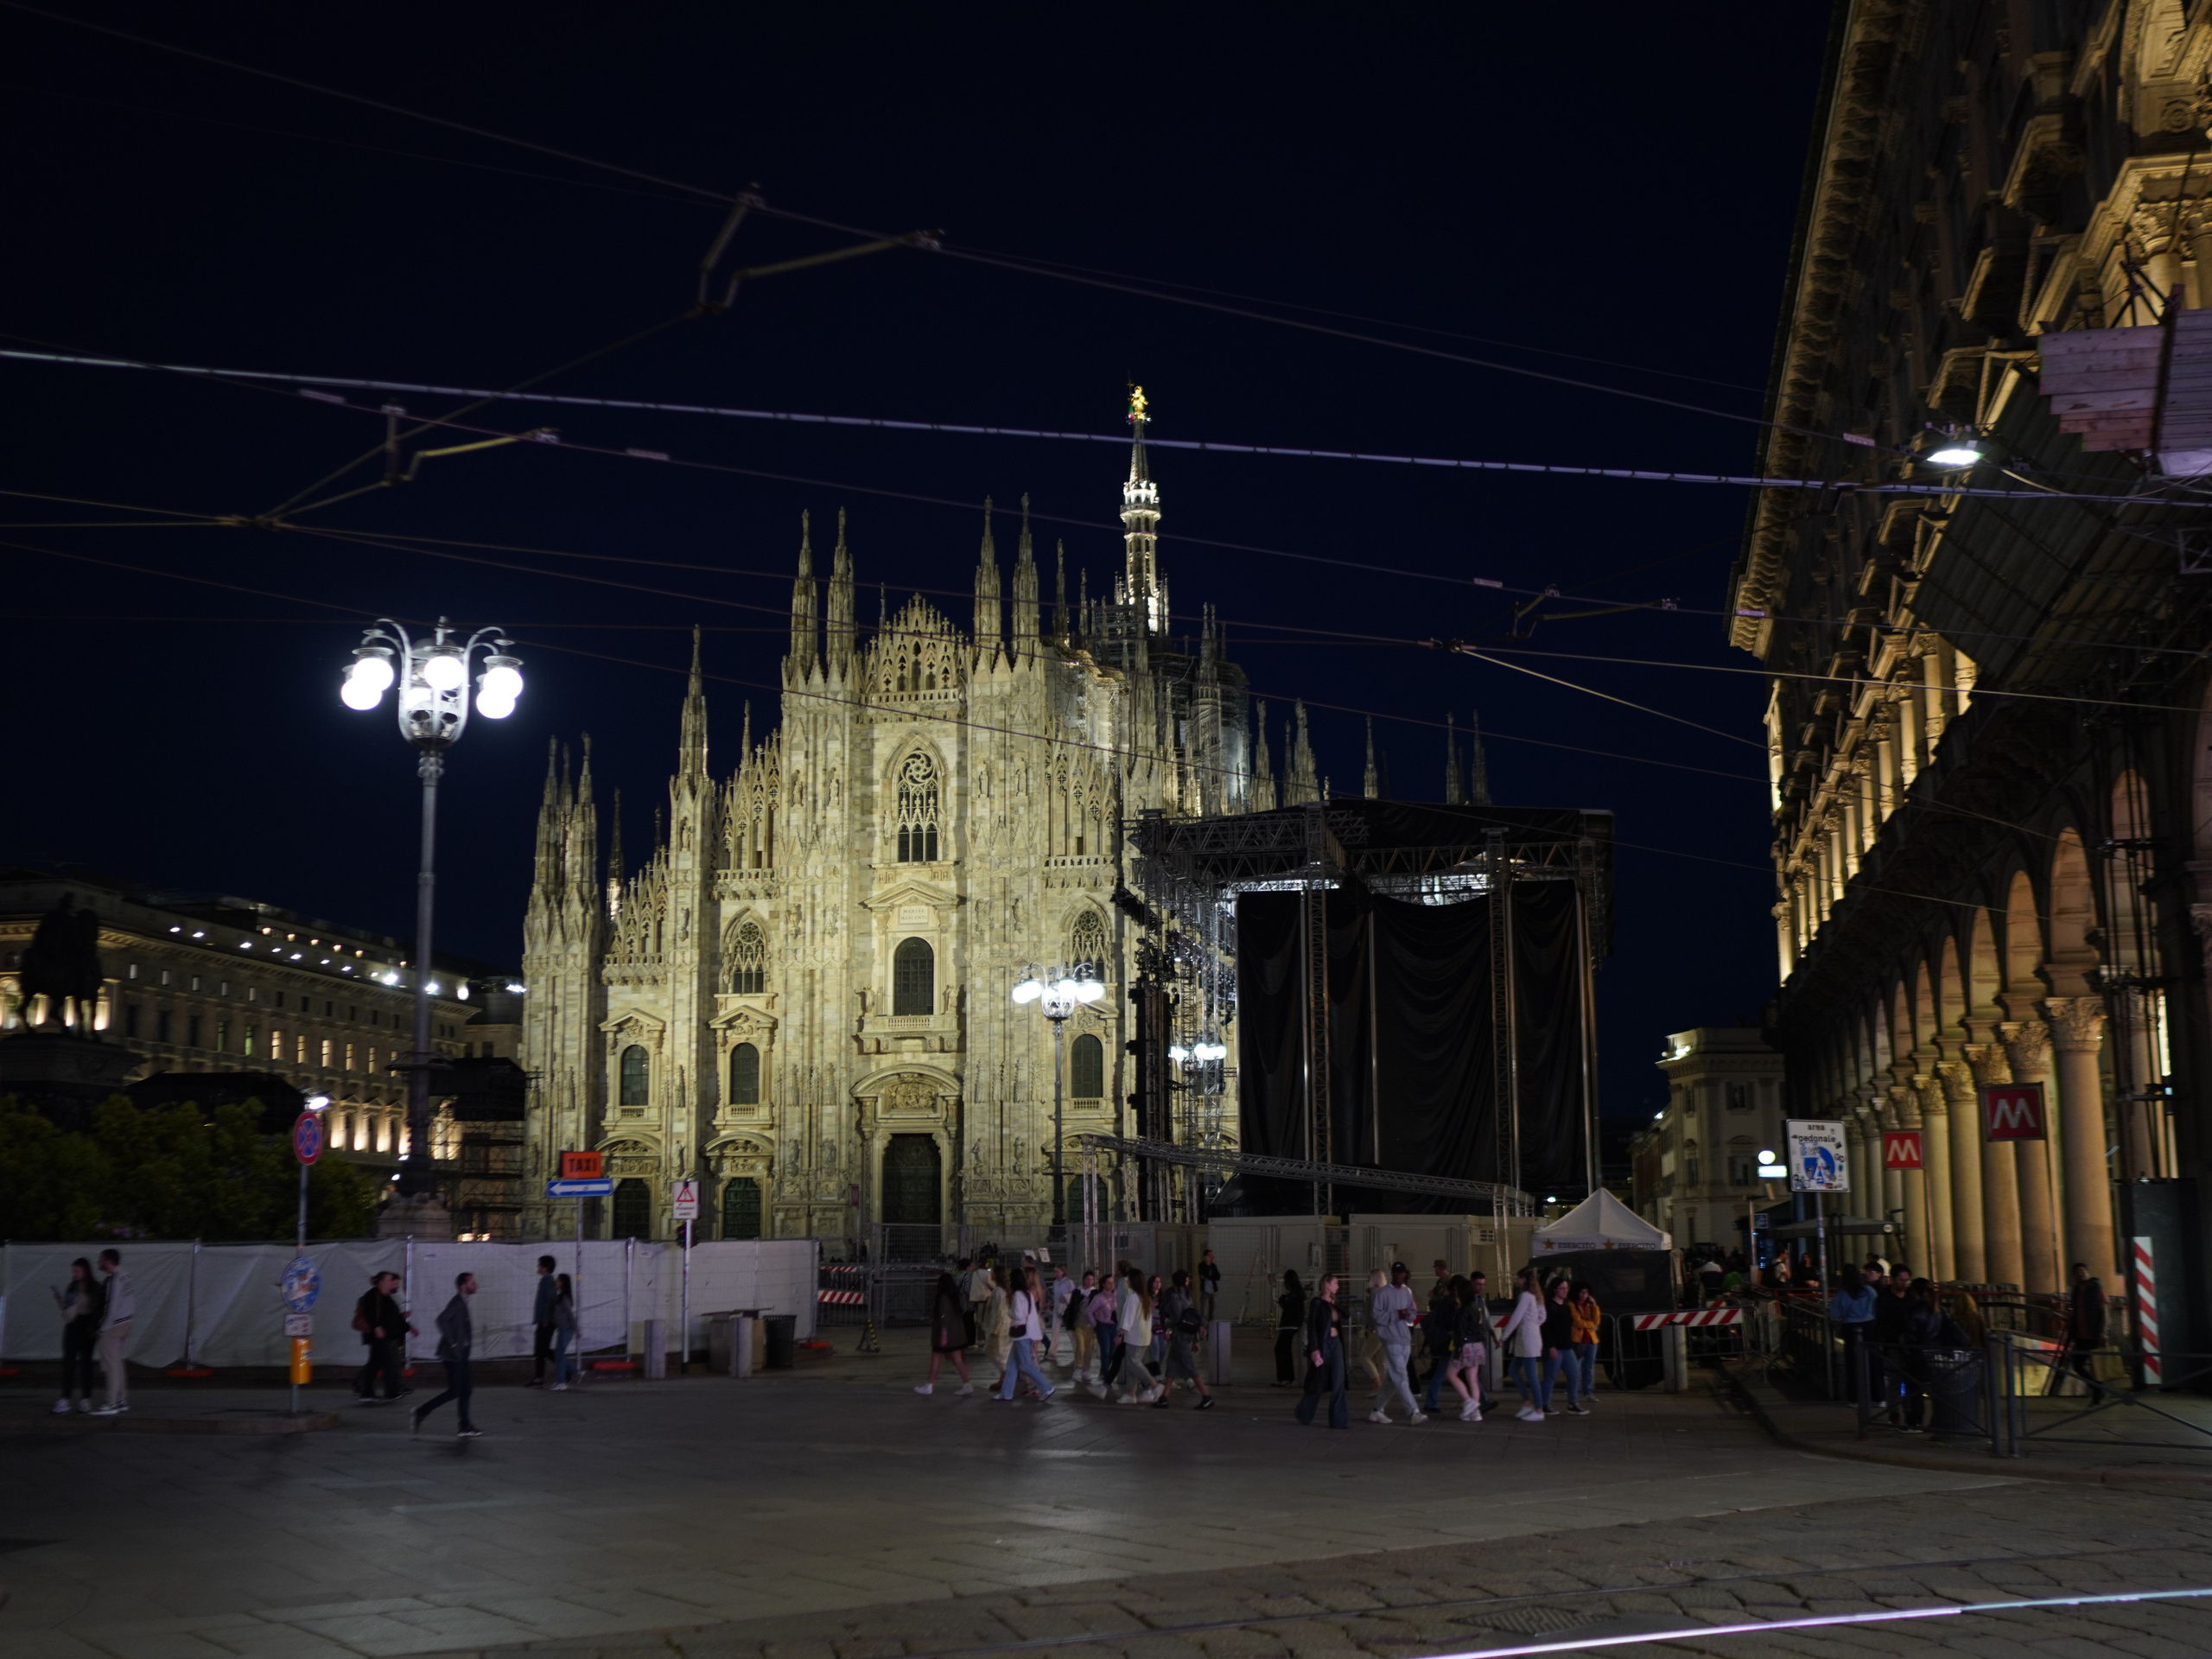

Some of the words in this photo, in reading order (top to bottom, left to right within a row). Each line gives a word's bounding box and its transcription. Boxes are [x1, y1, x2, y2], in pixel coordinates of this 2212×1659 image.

[1991, 1097, 2037, 1129] M
[1798, 1134, 1836, 1143] pedonale
[1886, 1139, 1919, 1161] M
[568, 1158, 597, 1173] TAXI
[1618, 1242, 1656, 1250] ESERCITO
